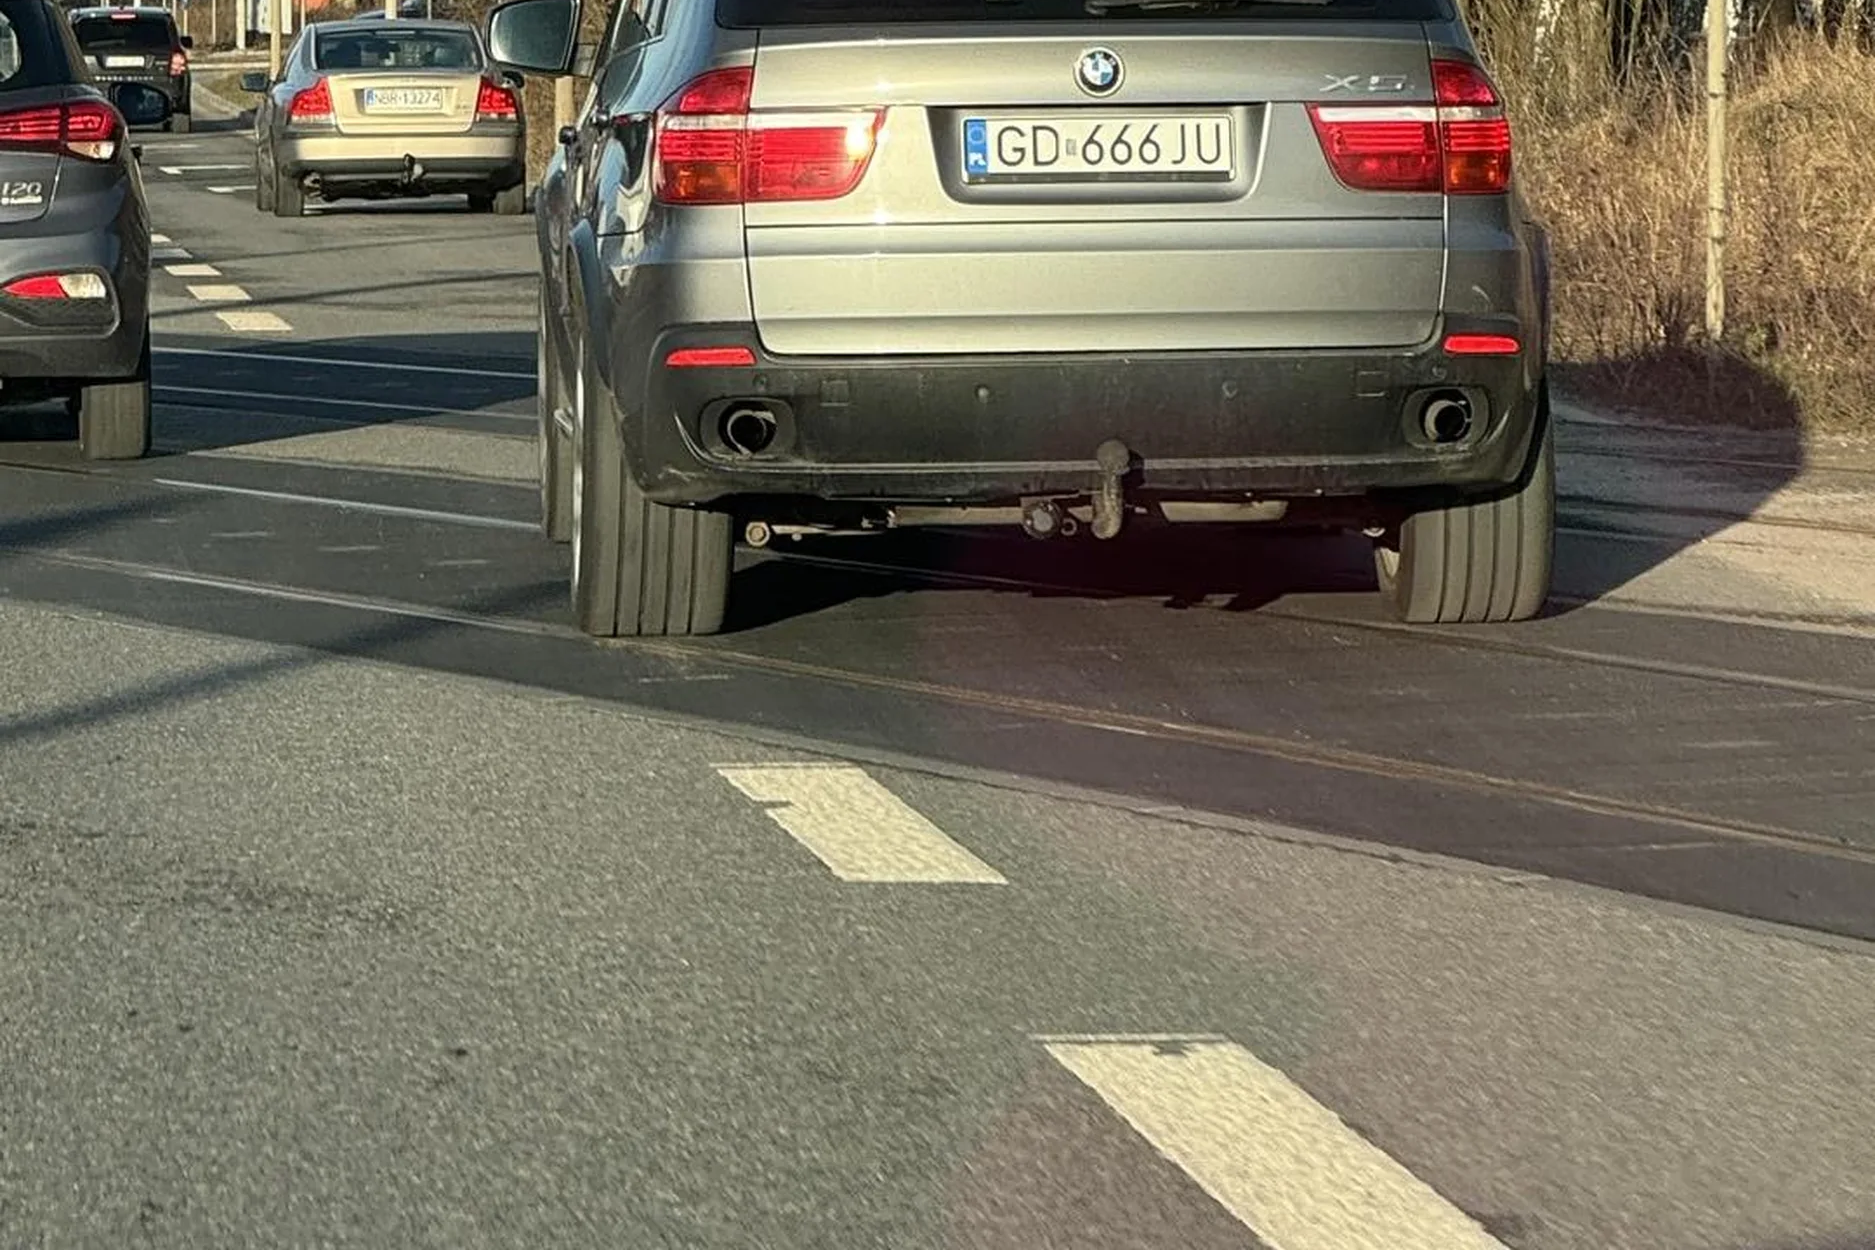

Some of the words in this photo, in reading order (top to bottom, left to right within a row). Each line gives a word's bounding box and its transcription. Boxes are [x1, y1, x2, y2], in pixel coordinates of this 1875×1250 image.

[1319, 74, 1408, 92] X5
[403, 91, 440, 105] 13274
[997, 124, 1060, 166] GD
[1081, 123, 1221, 166] 666JU
[969, 152, 986, 166] PL
